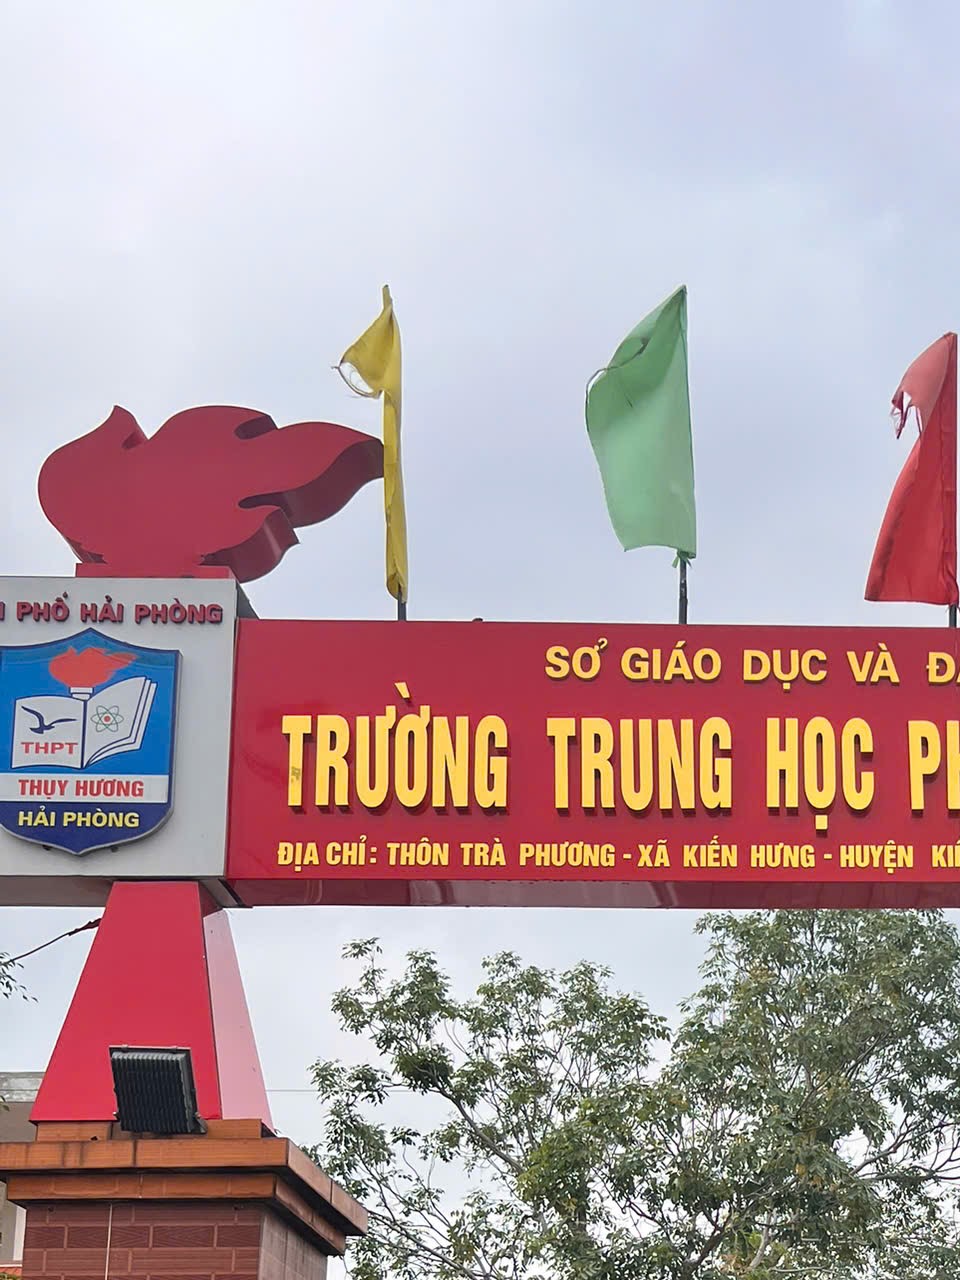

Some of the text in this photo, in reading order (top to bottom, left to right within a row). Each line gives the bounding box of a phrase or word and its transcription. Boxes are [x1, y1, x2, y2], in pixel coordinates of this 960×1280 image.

[80, 595, 125, 623] HẢI
[135, 598, 224, 624] PHÒNG
[546, 638, 607, 678] SỞ
[621, 641, 721, 680] GIÁO
[744, 650, 826, 689] DỤC
[847, 643, 899, 682] VÀ
[21, 742, 78, 754] THPT
[282, 683, 507, 807] TRƯỜNG
[547, 717, 731, 810] TRUNG
[767, 717, 874, 829] HỌC
[18, 778, 145, 800] THỤY HƯƠNG
[18, 805, 140, 827] HẢI PHÒNG
[278, 843, 319, 871] ĐỊA
[327, 835, 376, 865] CHỈ:
[387, 838, 448, 865] THÔN
[461, 838, 506, 865] TRÀ
[520, 842, 615, 866] PHƯƠNG
[638, 840, 670, 866] XÃ
[684, 836, 737, 867] KIẾN
[751, 844, 815, 867] HƯNG
[841, 840, 913, 873] HUYỆN
